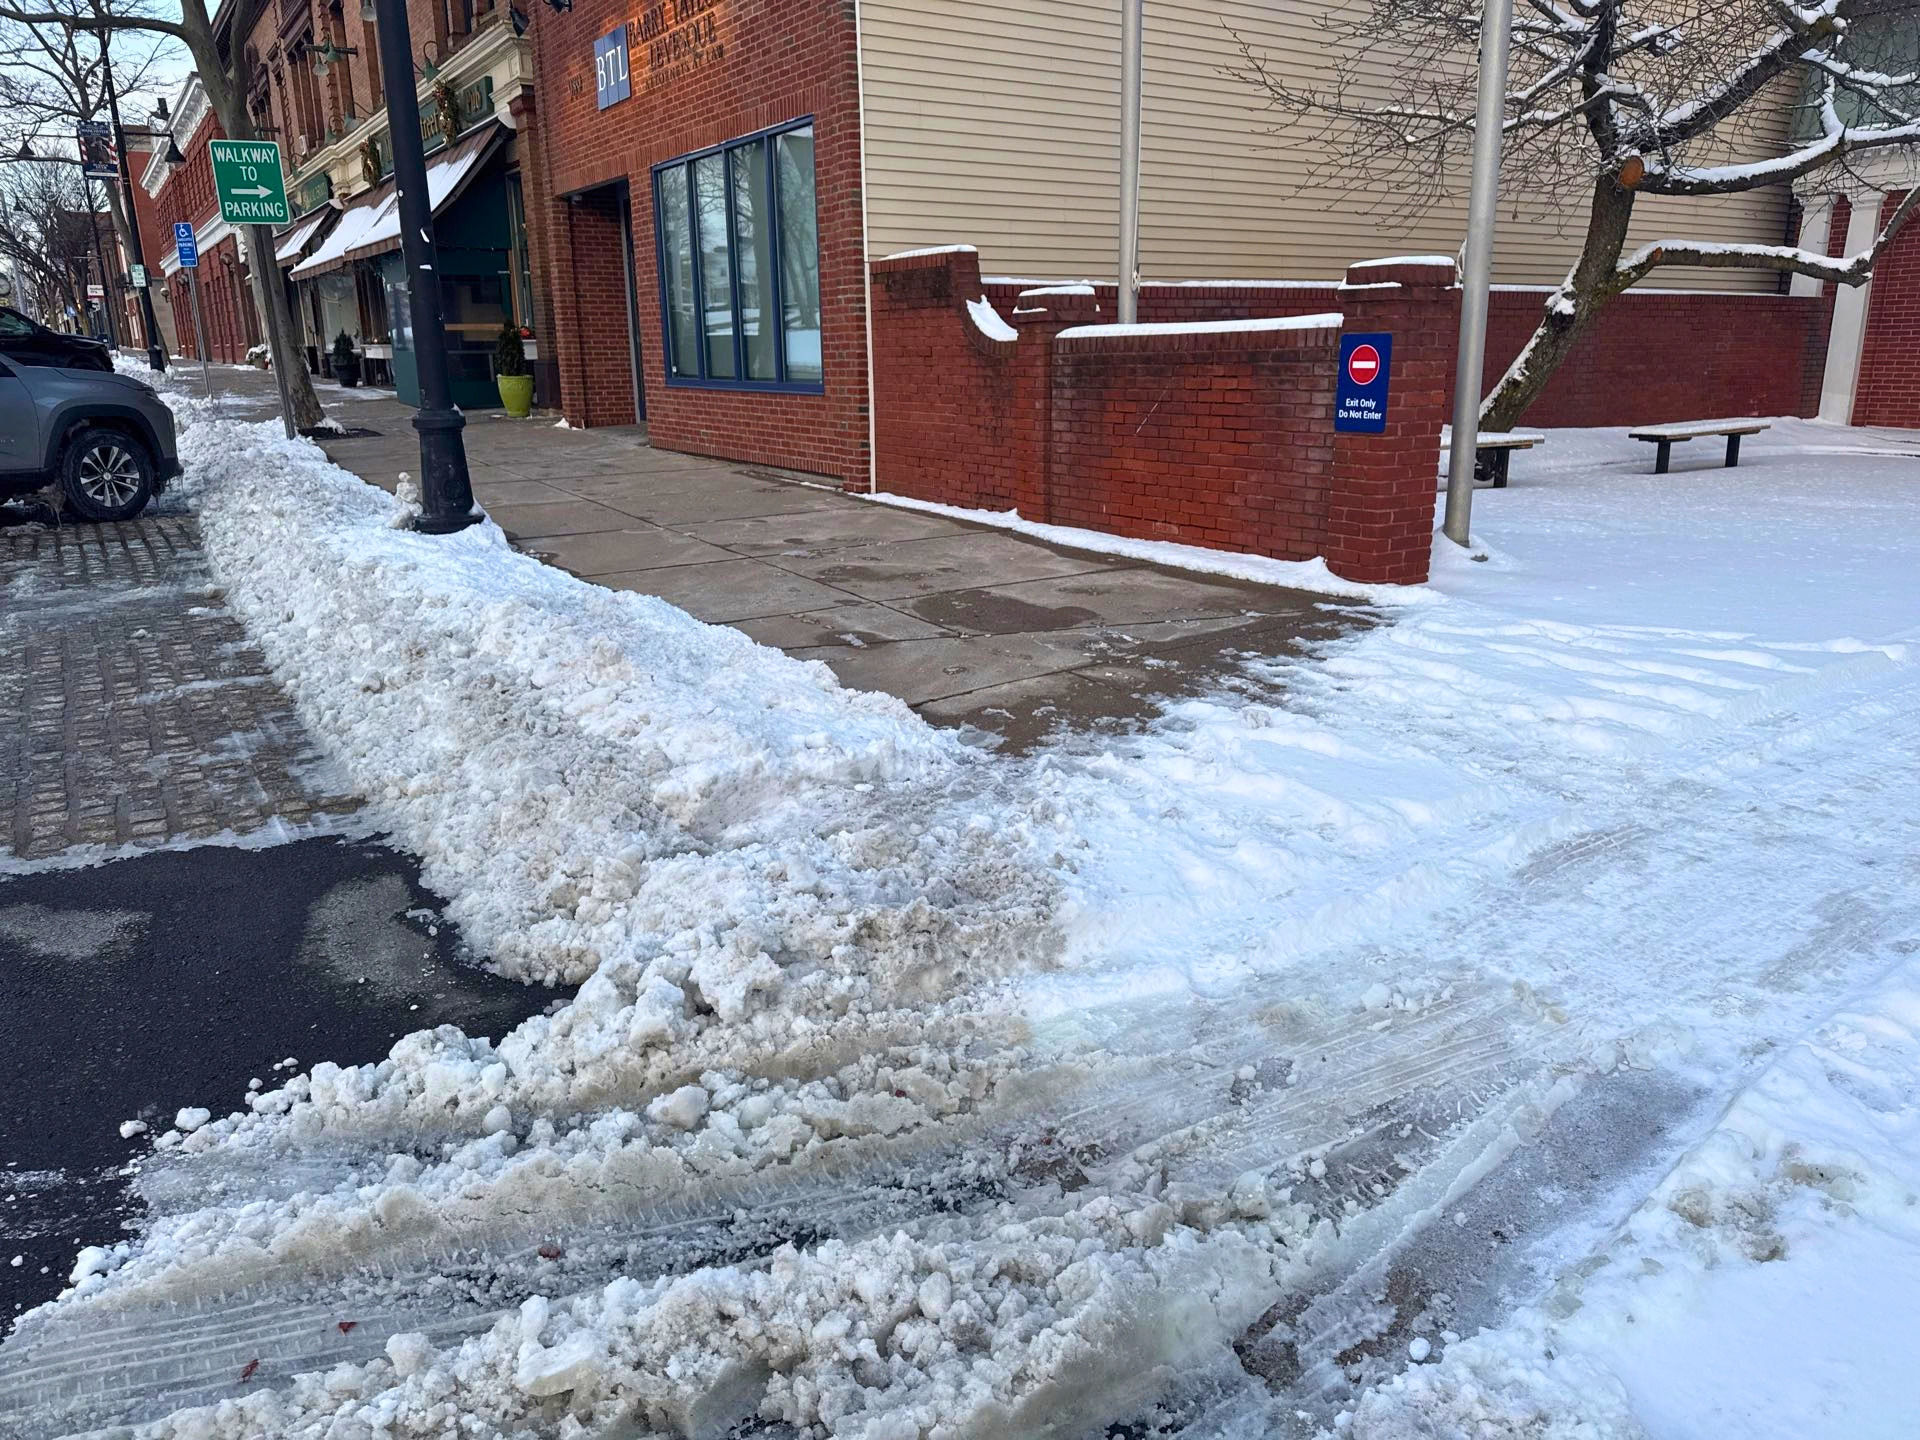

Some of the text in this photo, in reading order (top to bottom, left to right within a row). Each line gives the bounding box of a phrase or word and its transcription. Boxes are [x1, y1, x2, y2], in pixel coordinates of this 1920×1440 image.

[649, 11, 717, 70] LEVESQUE
[705, 43, 724, 64] LAW
[596, 45, 628, 92] BTL
[213, 146, 275, 164] WALKWAY
[240, 165, 257, 181] TO
[224, 201, 284, 218] PARKING
[1346, 398, 1376, 409] Exit Only
[1338, 409, 1382, 419] Do Not Enter
